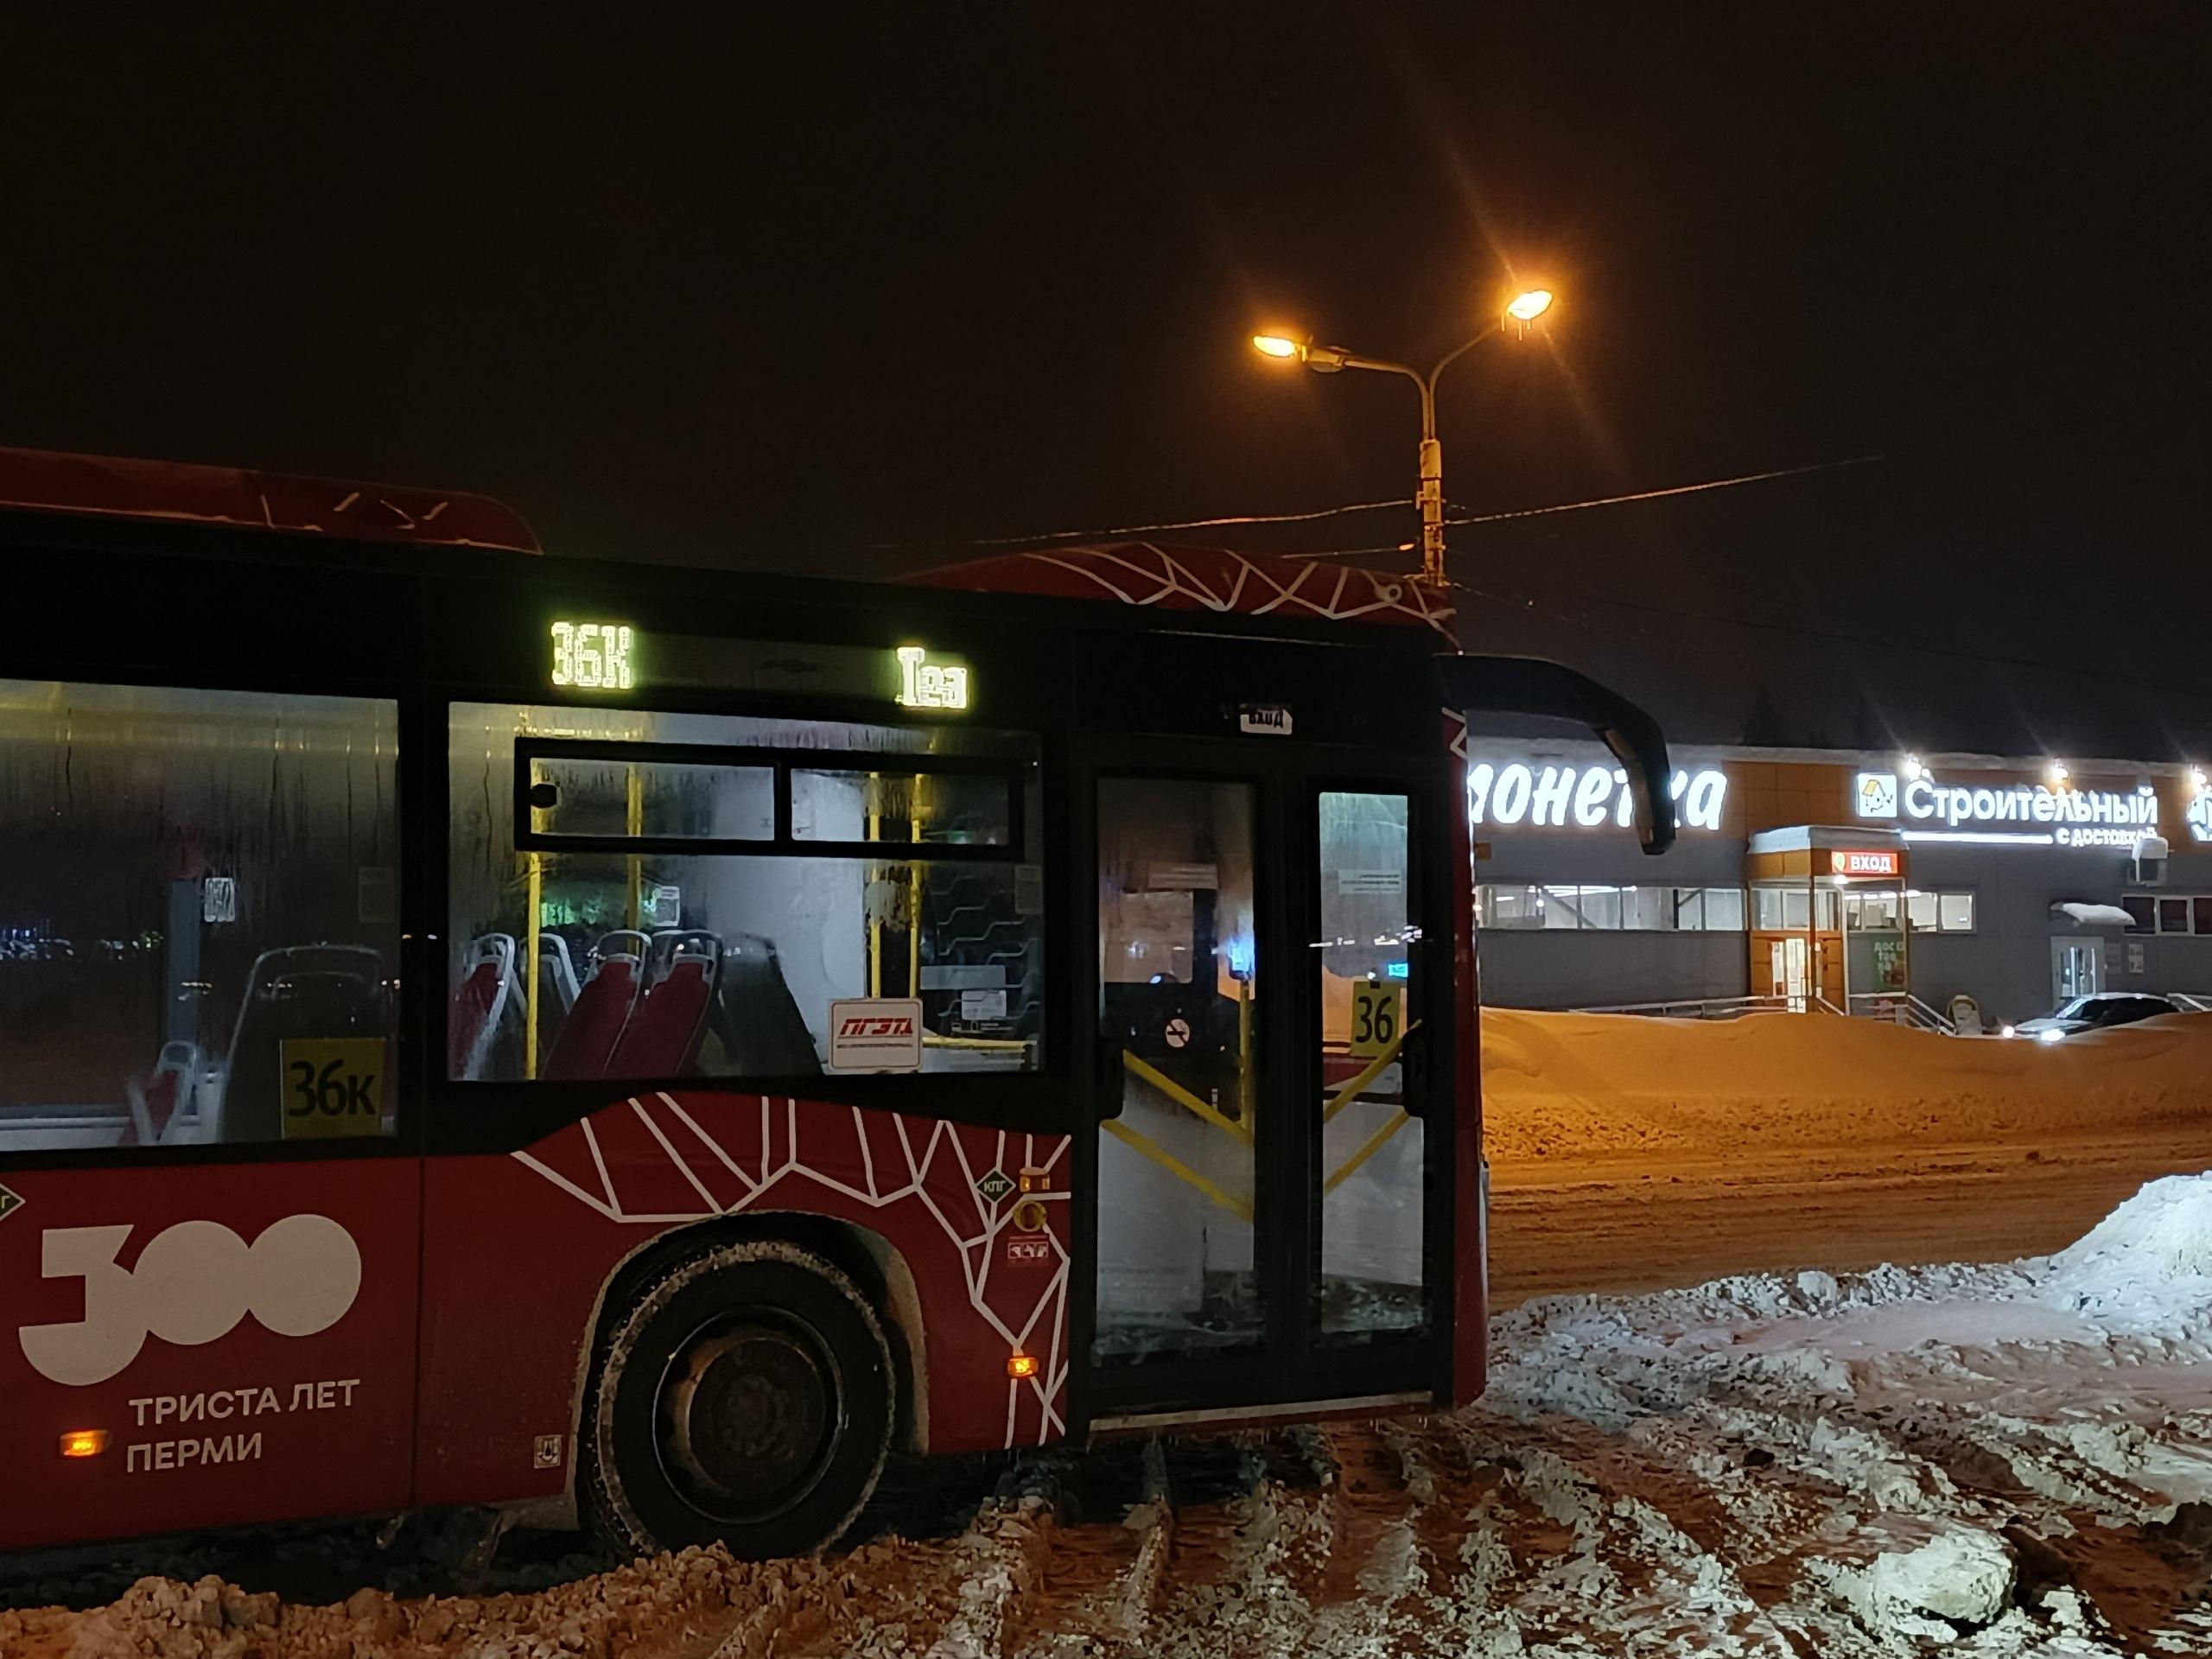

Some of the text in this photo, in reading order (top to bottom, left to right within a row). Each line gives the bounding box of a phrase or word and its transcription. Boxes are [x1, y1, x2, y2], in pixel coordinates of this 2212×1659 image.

[1904, 779, 2158, 826] Строительный
[1850, 855, 1892, 872] ВХОД
[1355, 995, 1393, 1044] 36
[19, 1214, 361, 1386] 300
[129, 1378, 360, 1426] ТРИСТА ЛЕТ
[127, 1433, 262, 1472] ПЕРМИ
